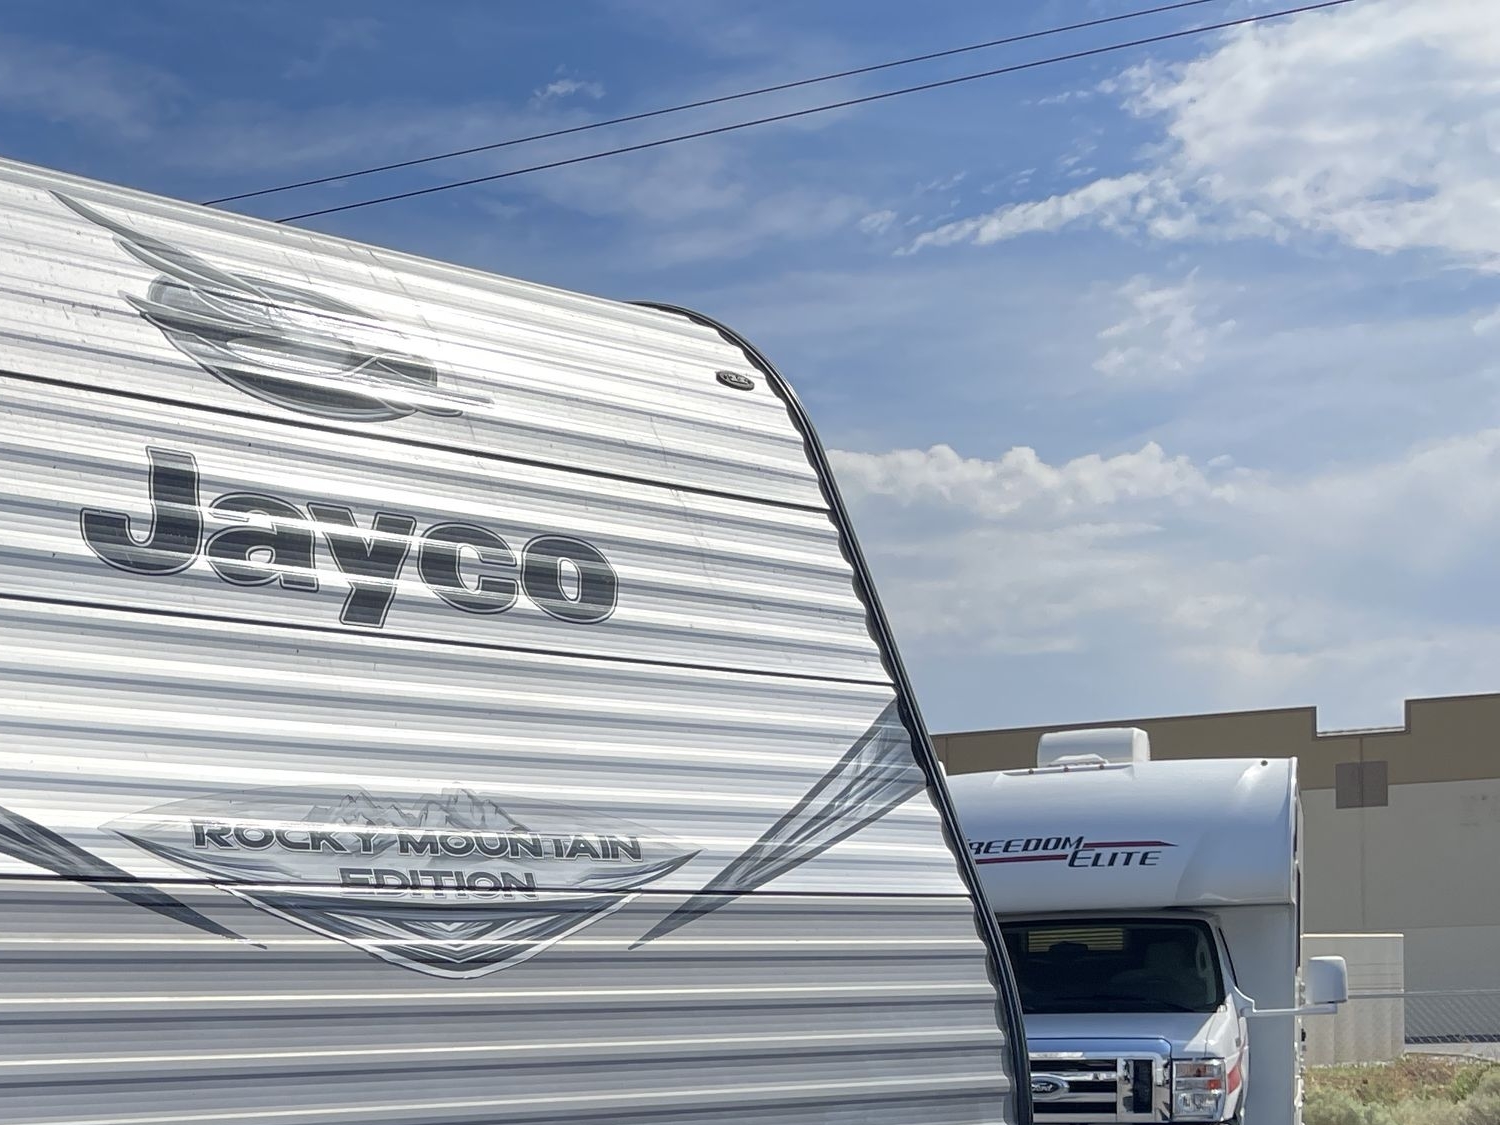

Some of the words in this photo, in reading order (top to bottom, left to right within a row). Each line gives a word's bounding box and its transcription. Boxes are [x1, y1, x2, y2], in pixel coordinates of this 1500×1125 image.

[79, 445, 619, 629] Jayco
[191, 819, 376, 856] ROCKY
[397, 828, 644, 863] MOUNTAIN
[968, 836, 1085, 855] REEDOM
[1067, 848, 1163, 868] ELITE
[338, 866, 540, 900] EDITION
